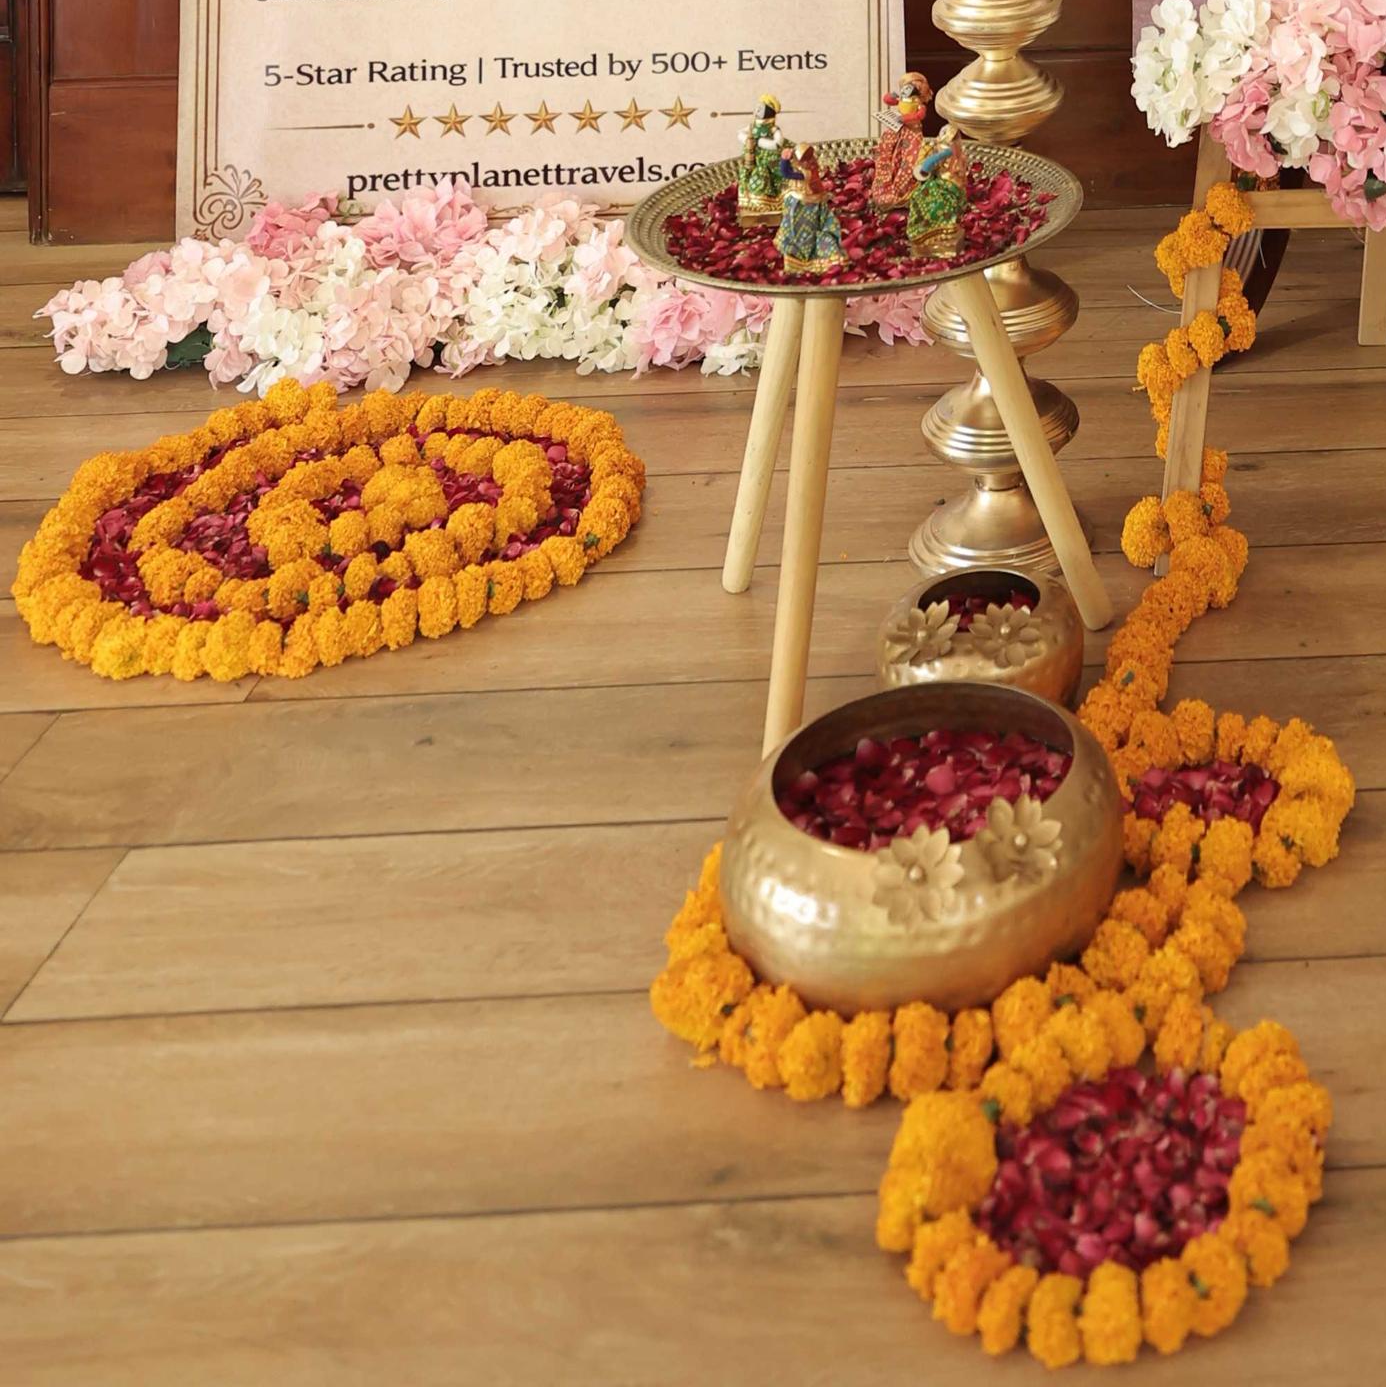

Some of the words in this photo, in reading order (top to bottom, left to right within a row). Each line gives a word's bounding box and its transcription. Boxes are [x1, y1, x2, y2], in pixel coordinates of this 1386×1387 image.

[263, 60, 358, 87] 5-Star
[367, 57, 468, 88] Rating
[493, 53, 599, 81] Trusted
[607, 51, 644, 82] by
[650, 50, 729, 75] 500+
[736, 47, 829, 73] Events
